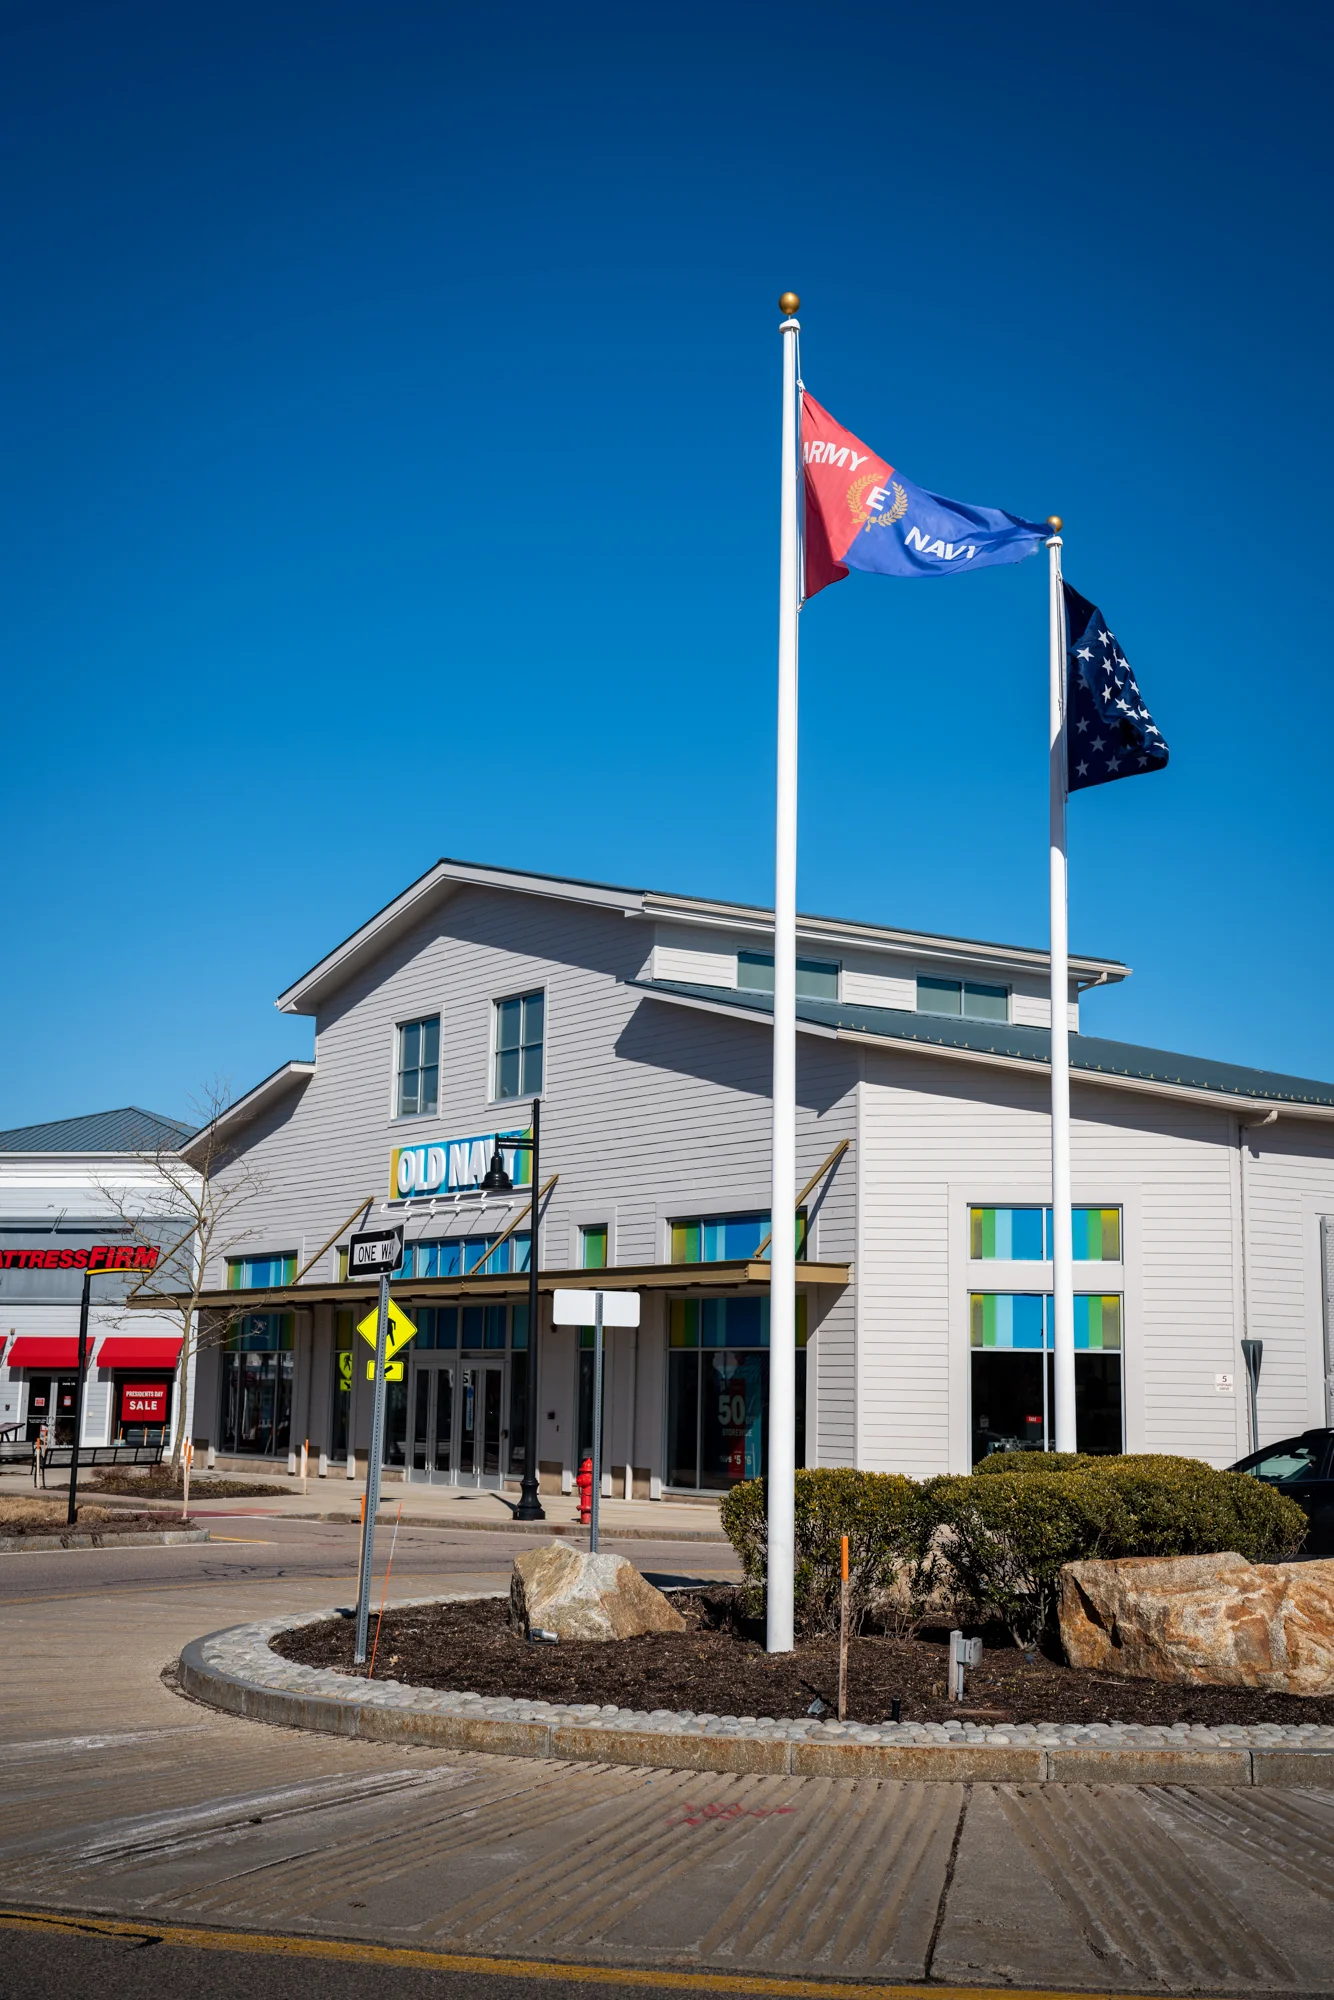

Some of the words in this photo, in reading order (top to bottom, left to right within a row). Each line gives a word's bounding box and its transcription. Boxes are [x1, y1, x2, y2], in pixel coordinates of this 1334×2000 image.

[802, 440, 869, 472] ARMY
[865, 485, 891, 512] E
[397, 1147, 447, 1193] OLD
[0, 1250, 90, 1269] TTRESS
[88, 1246, 160, 1269] FIRM
[358, 1244, 377, 1263] ONE
[1222, 1375, 1228, 1383] 5
[129, 1400, 158, 1411] SALE
